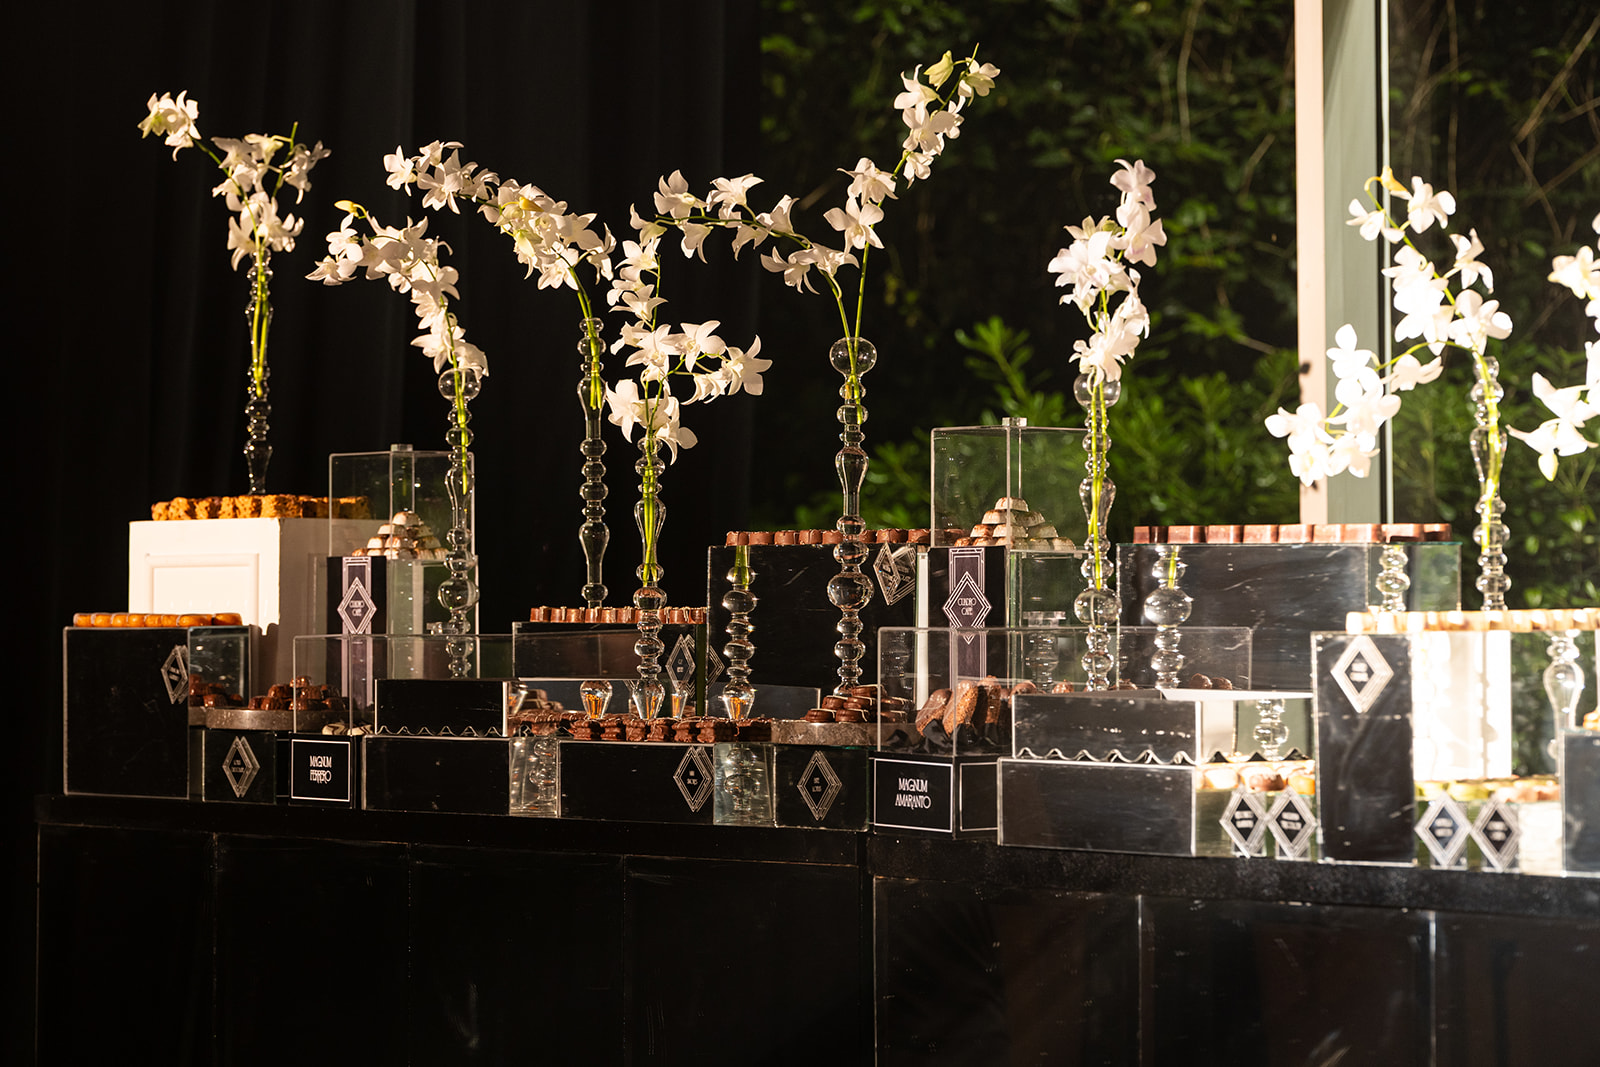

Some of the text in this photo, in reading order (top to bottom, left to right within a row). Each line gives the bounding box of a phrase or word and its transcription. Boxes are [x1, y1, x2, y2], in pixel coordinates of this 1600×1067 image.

[309, 755, 332, 768] MAGNUM
[309, 769, 332, 784] FERRERO
[898, 777, 928, 793] MAGNUM
[894, 793, 932, 810] AMARANTO
